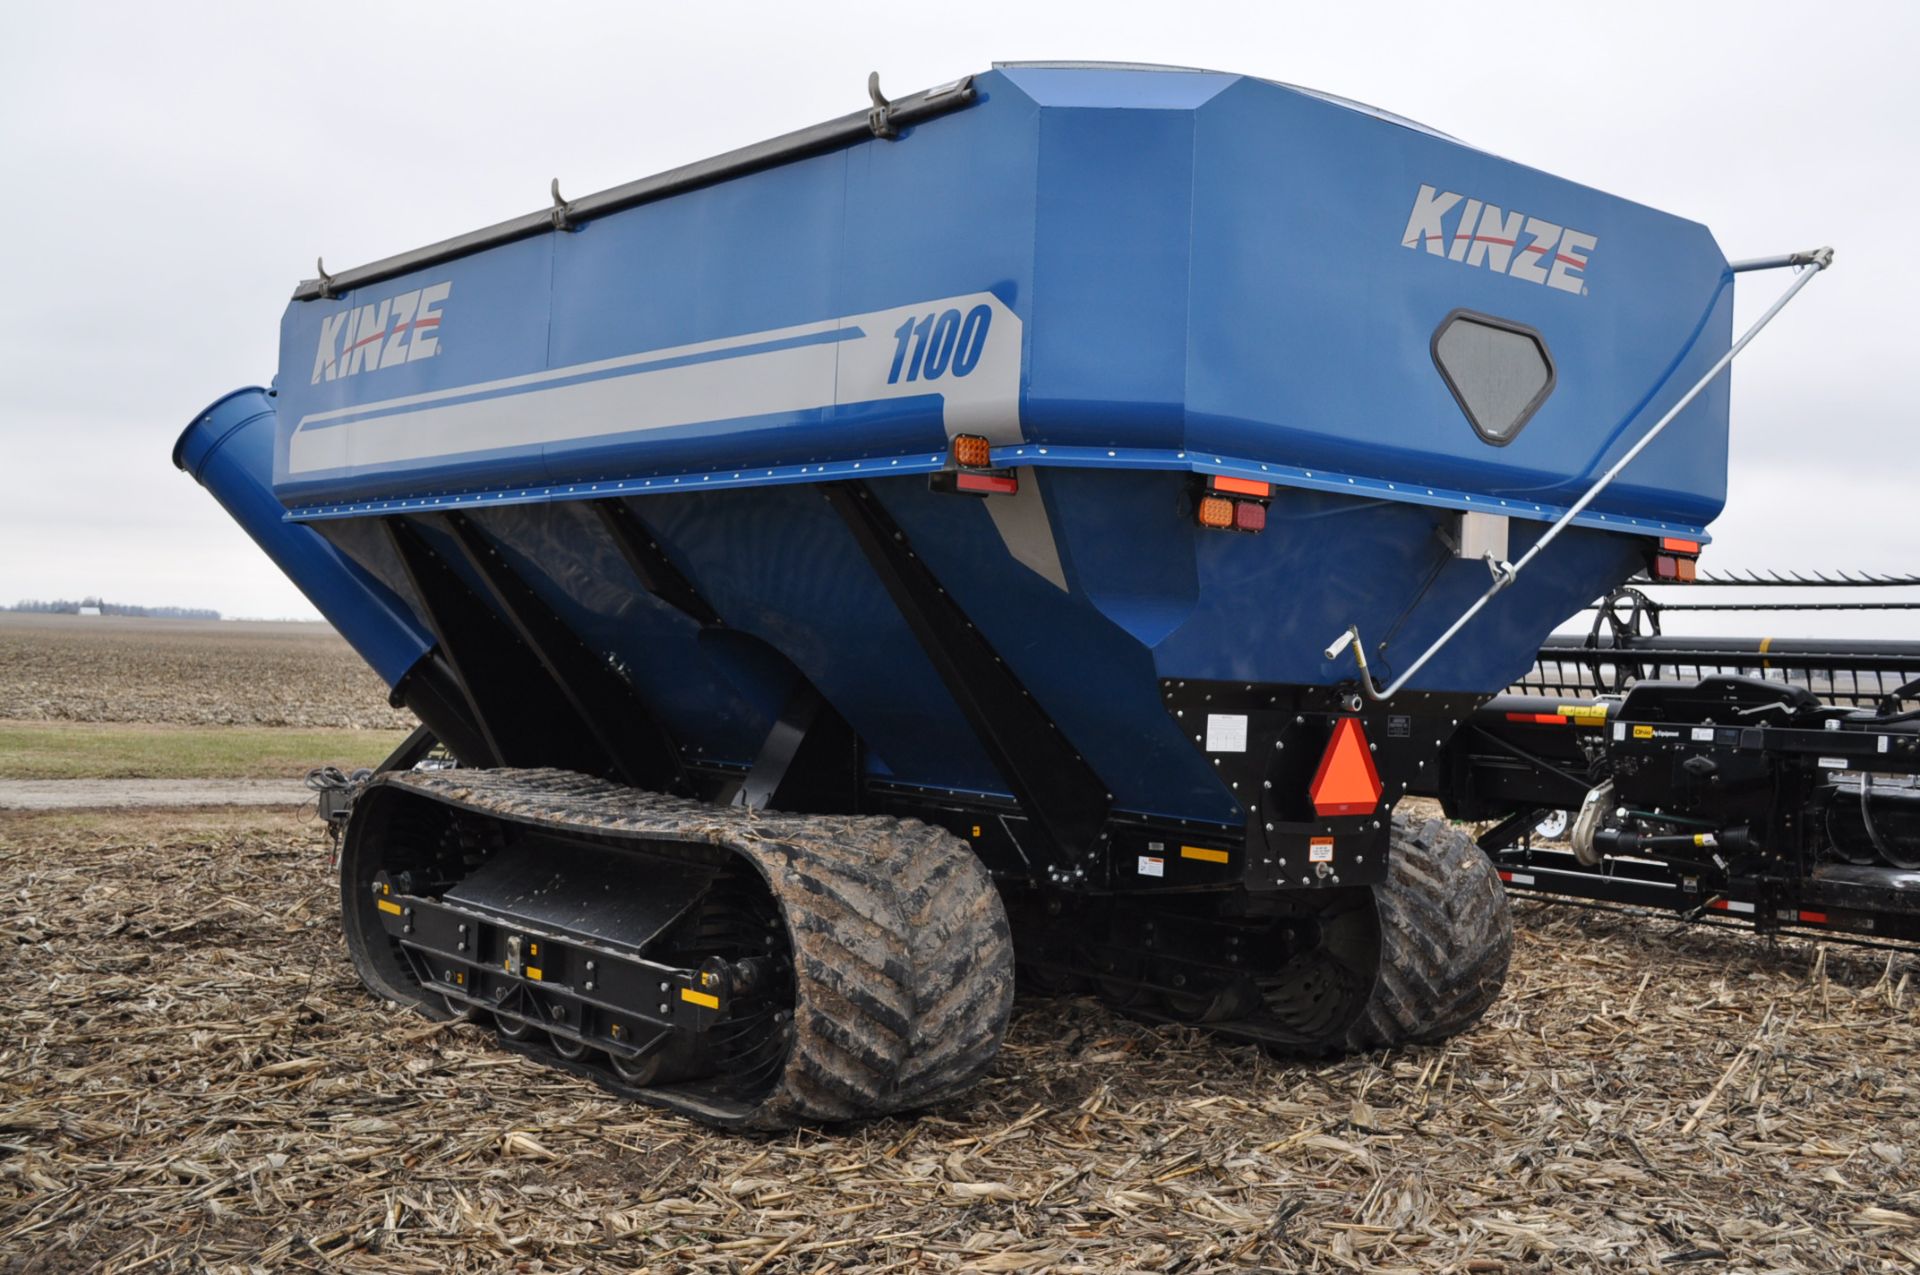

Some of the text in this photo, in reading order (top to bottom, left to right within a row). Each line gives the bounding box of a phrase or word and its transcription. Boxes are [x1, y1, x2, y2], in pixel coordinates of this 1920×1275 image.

[1401, 184, 1598, 295] KINZE
[311, 281, 452, 385] KINZE
[887, 304, 992, 385] 1100
